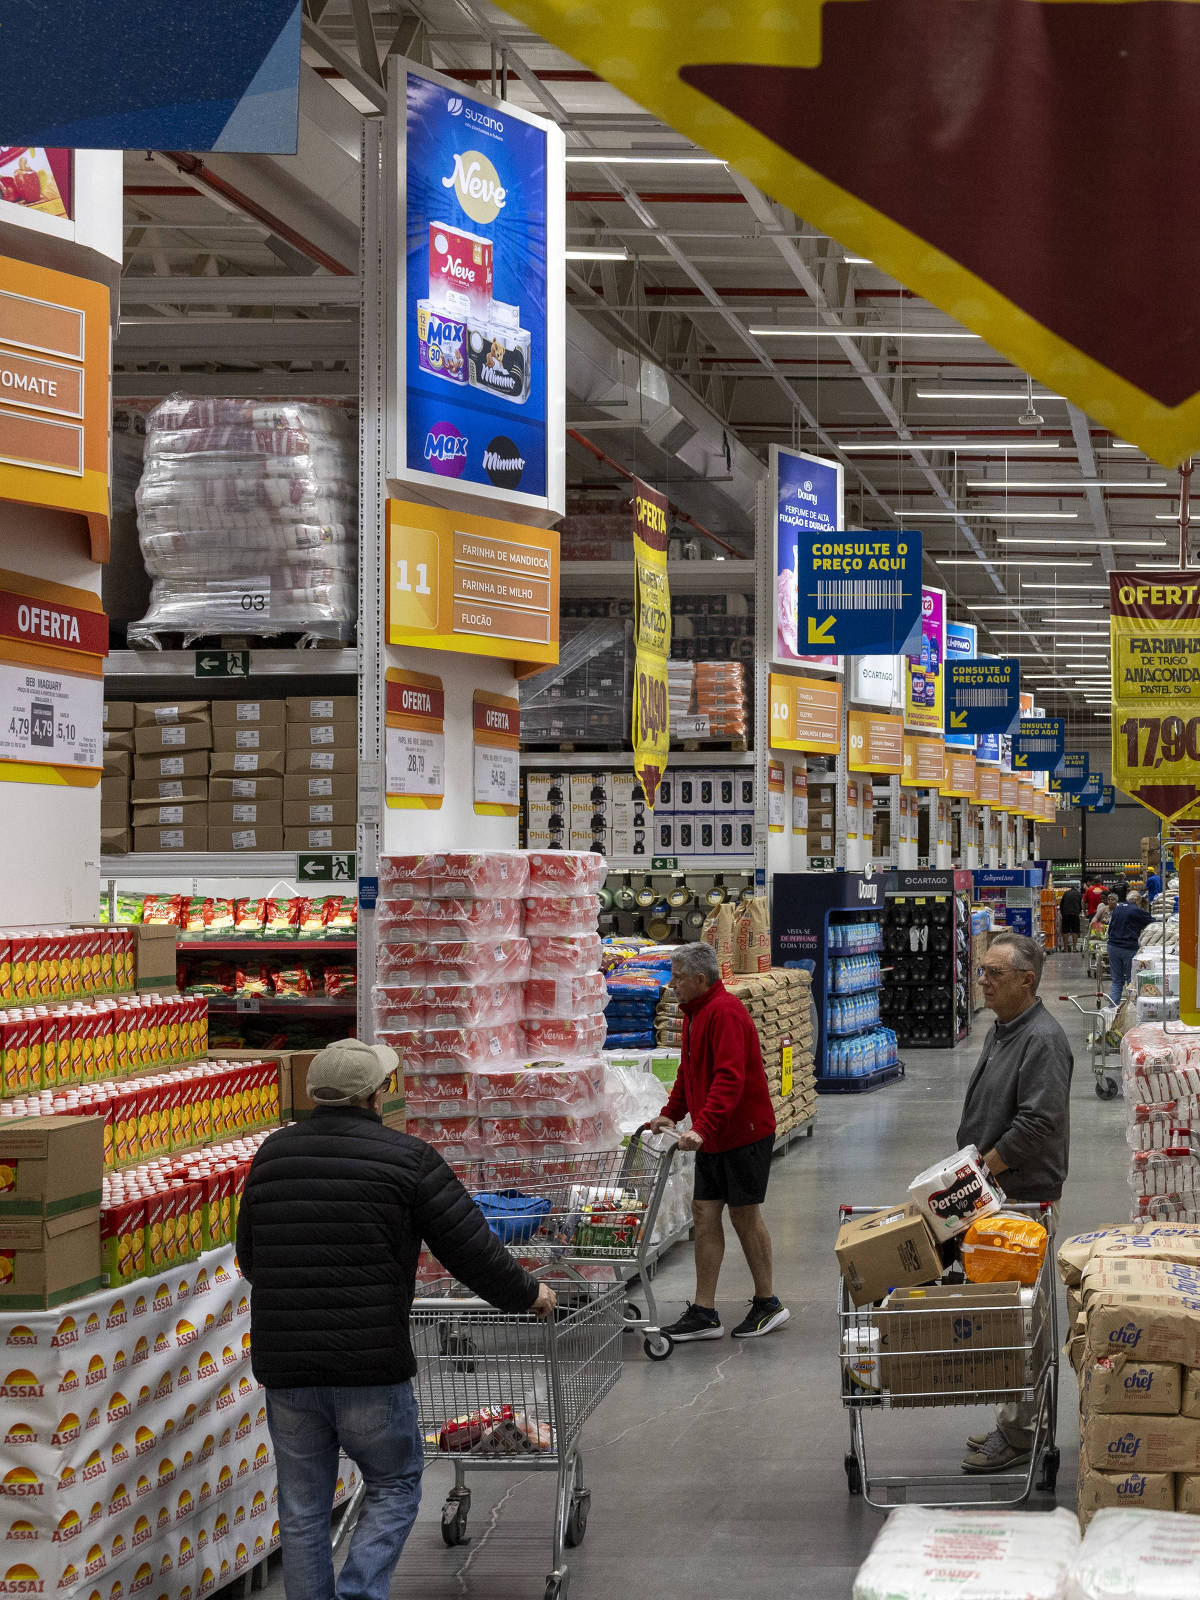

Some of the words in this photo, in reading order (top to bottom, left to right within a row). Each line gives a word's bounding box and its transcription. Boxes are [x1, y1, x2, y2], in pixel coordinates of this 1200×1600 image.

[465, 108, 504, 133] suzano
[442, 153, 508, 208] Neve
[441, 254, 476, 282] Neve
[427, 321, 463, 346] Max
[430, 348, 441, 362] 30
[0, 369, 57, 397] OMATE
[424, 433, 468, 461] Max
[797, 489, 818, 506] Downy
[635, 496, 667, 535] OFERTA
[779, 514, 804, 527] FIXAÇÃO
[785, 505, 809, 518] PERFUME
[809, 510, 817, 519] DE
[818, 511, 830, 522] ALTA
[462, 544, 495, 560] FARINHA
[497, 550, 508, 561] DE
[509, 552, 549, 569] MANDIOCA
[812, 543, 890, 556] CONSULTE
[897, 543, 908, 555] O
[812, 558, 863, 574] PREÇO
[868, 558, 906, 571] AQUI
[396, 559, 431, 595] 11
[462, 579, 495, 593] FARINHA
[497, 586, 507, 596] DE
[509, 587, 533, 599] MILHO
[240, 594, 266, 612] 03
[17, 604, 81, 643] OFERTA
[461, 613, 492, 626] FLOCÃO
[952, 666, 1000, 674] CONSULTE
[1004, 666, 1011, 674] O
[1142, 656, 1155, 666] DE
[1157, 656, 1188, 666] TRIGO
[953, 676, 984, 685] PREÇO
[986, 675, 1010, 684] AQUI
[1140, 685, 1172, 694] PASTEL
[1173, 685, 1192, 694] 5KG
[402, 690, 431, 713] OFERTA
[486, 709, 509, 730] OFERTA
[772, 702, 789, 720] 10
[695, 722, 706, 732] 07
[851, 735, 864, 748] 09
[530, 776, 555, 784] Philco
[572, 776, 597, 784] Philco
[613, 776, 638, 784] Philco
[530, 804, 556, 812] Philco
[529, 831, 555, 839] Philco
[571, 831, 597, 839] Philco
[929, 1174, 983, 1212] Personal
[1109, 1327, 1144, 1348] chef
[1124, 1371, 1154, 1391] chef
[1107, 1437, 1142, 1458] chef
[1116, 1477, 1146, 1496] chef
